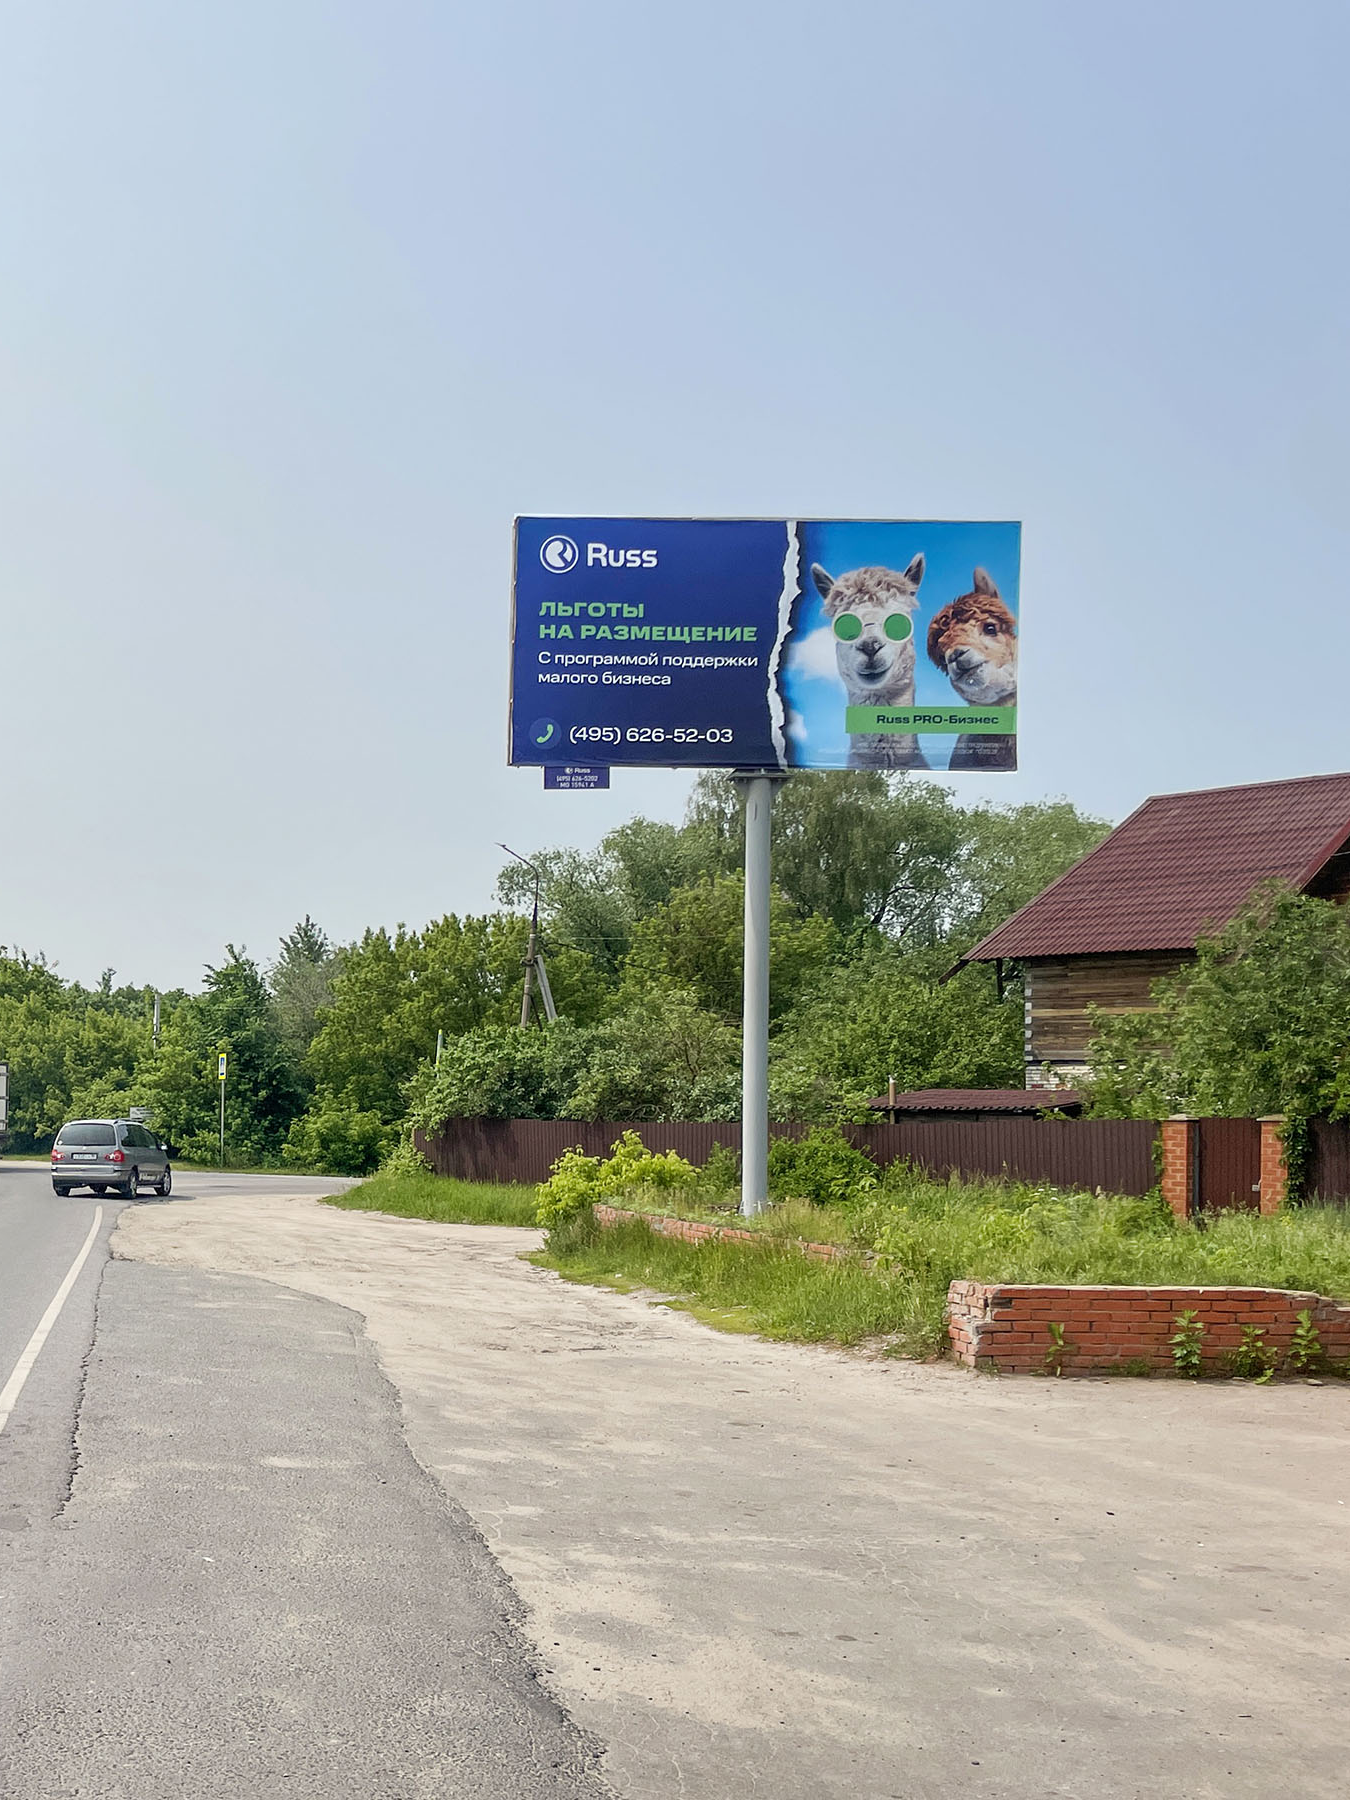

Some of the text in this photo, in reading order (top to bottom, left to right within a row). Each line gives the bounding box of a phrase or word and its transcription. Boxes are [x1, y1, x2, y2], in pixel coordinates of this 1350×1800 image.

[586, 542, 658, 568] Russ
[538, 601, 645, 618] ЛЬГОТЫ
[538, 624, 758, 644] НА РАЗМЕЩЕНИЕ
[538, 651, 758, 670] С программой поддержки
[537, 672, 672, 686] малого бизнеса
[876, 714, 999, 725] Russ PRO-Бизнес
[569, 725, 734, 745] (495) 626-52-03
